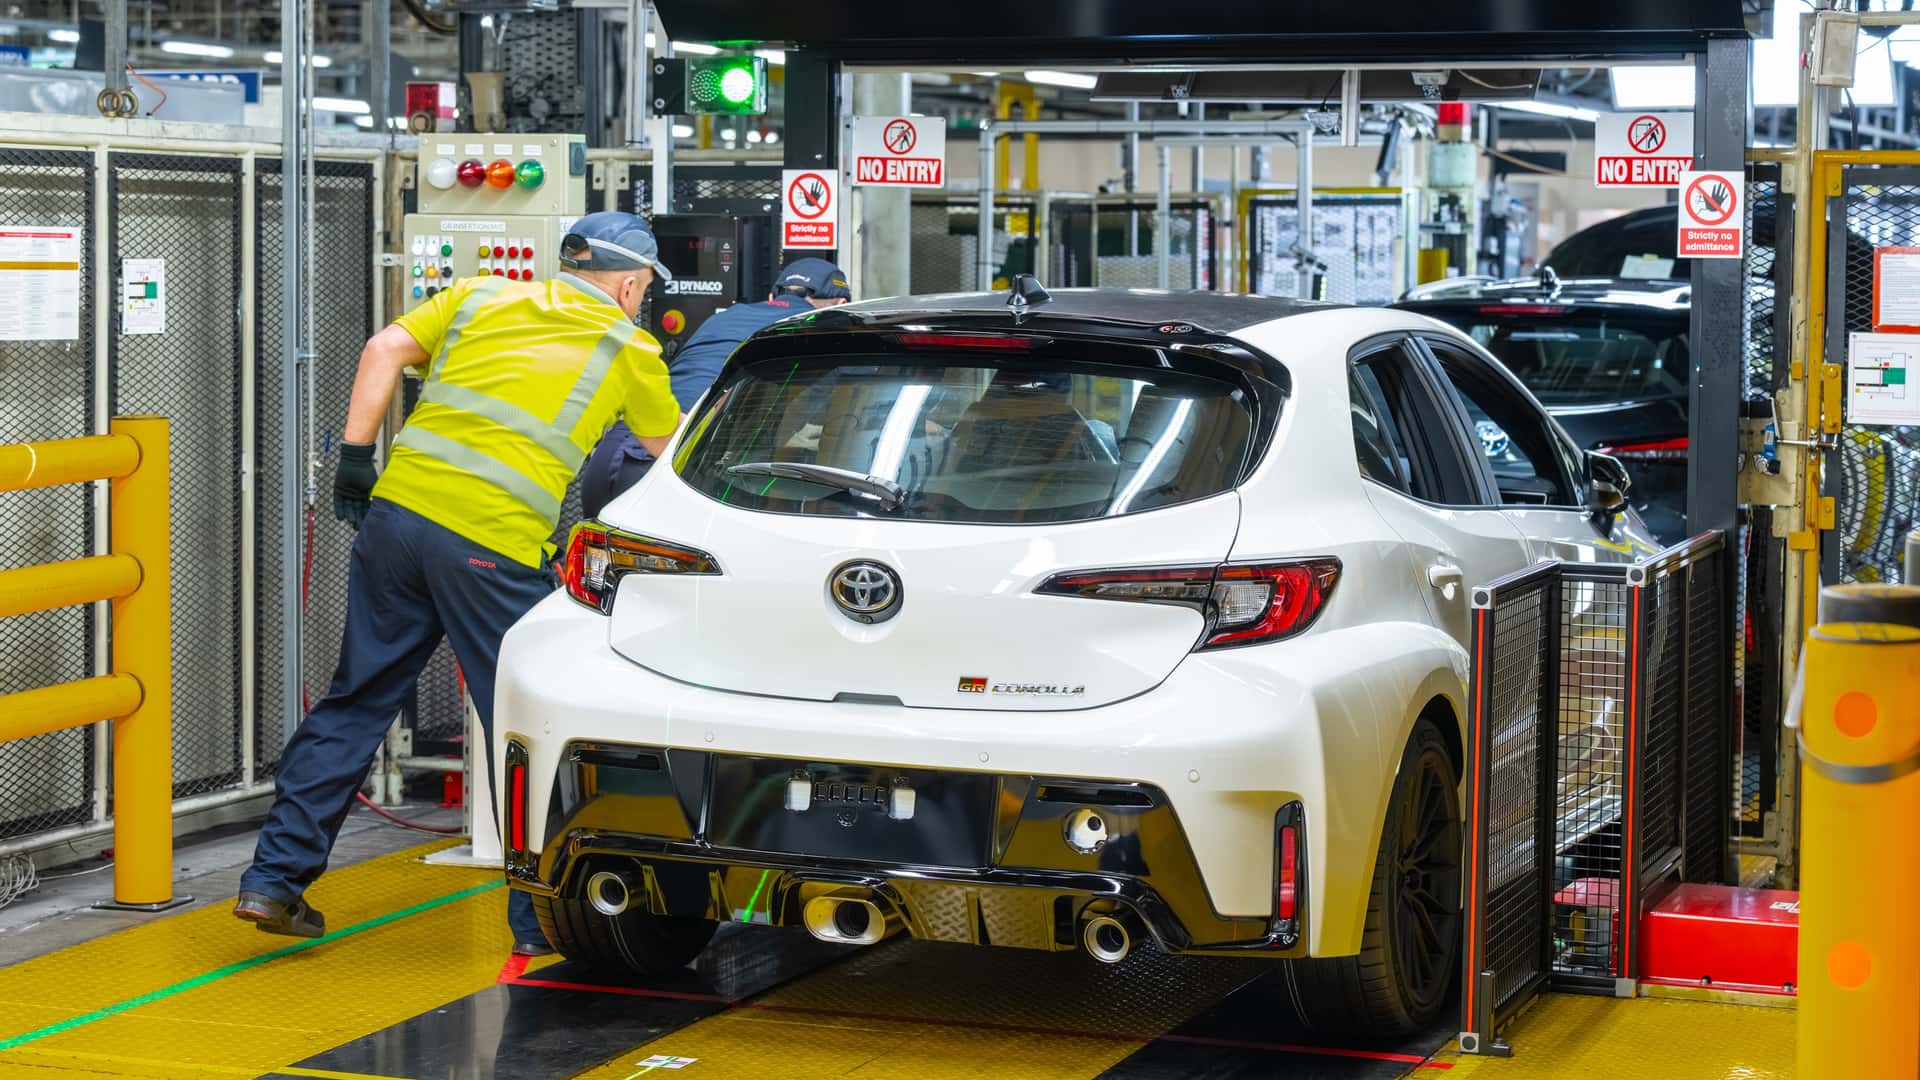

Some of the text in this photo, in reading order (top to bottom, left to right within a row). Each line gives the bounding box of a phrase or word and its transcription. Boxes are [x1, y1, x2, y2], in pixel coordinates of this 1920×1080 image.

[859, 158, 939, 182] NO ENTRY
[1601, 159, 1628, 182] NO
[790, 224, 817, 234] Strictly
[789, 235, 830, 243] admittance
[1687, 231, 1719, 241] Strictly
[1685, 242, 1734, 251] admittance
[680, 280, 723, 291] DYNACO
[468, 557, 496, 568] TOYOTA
[991, 682, 1086, 696] COROLLA
